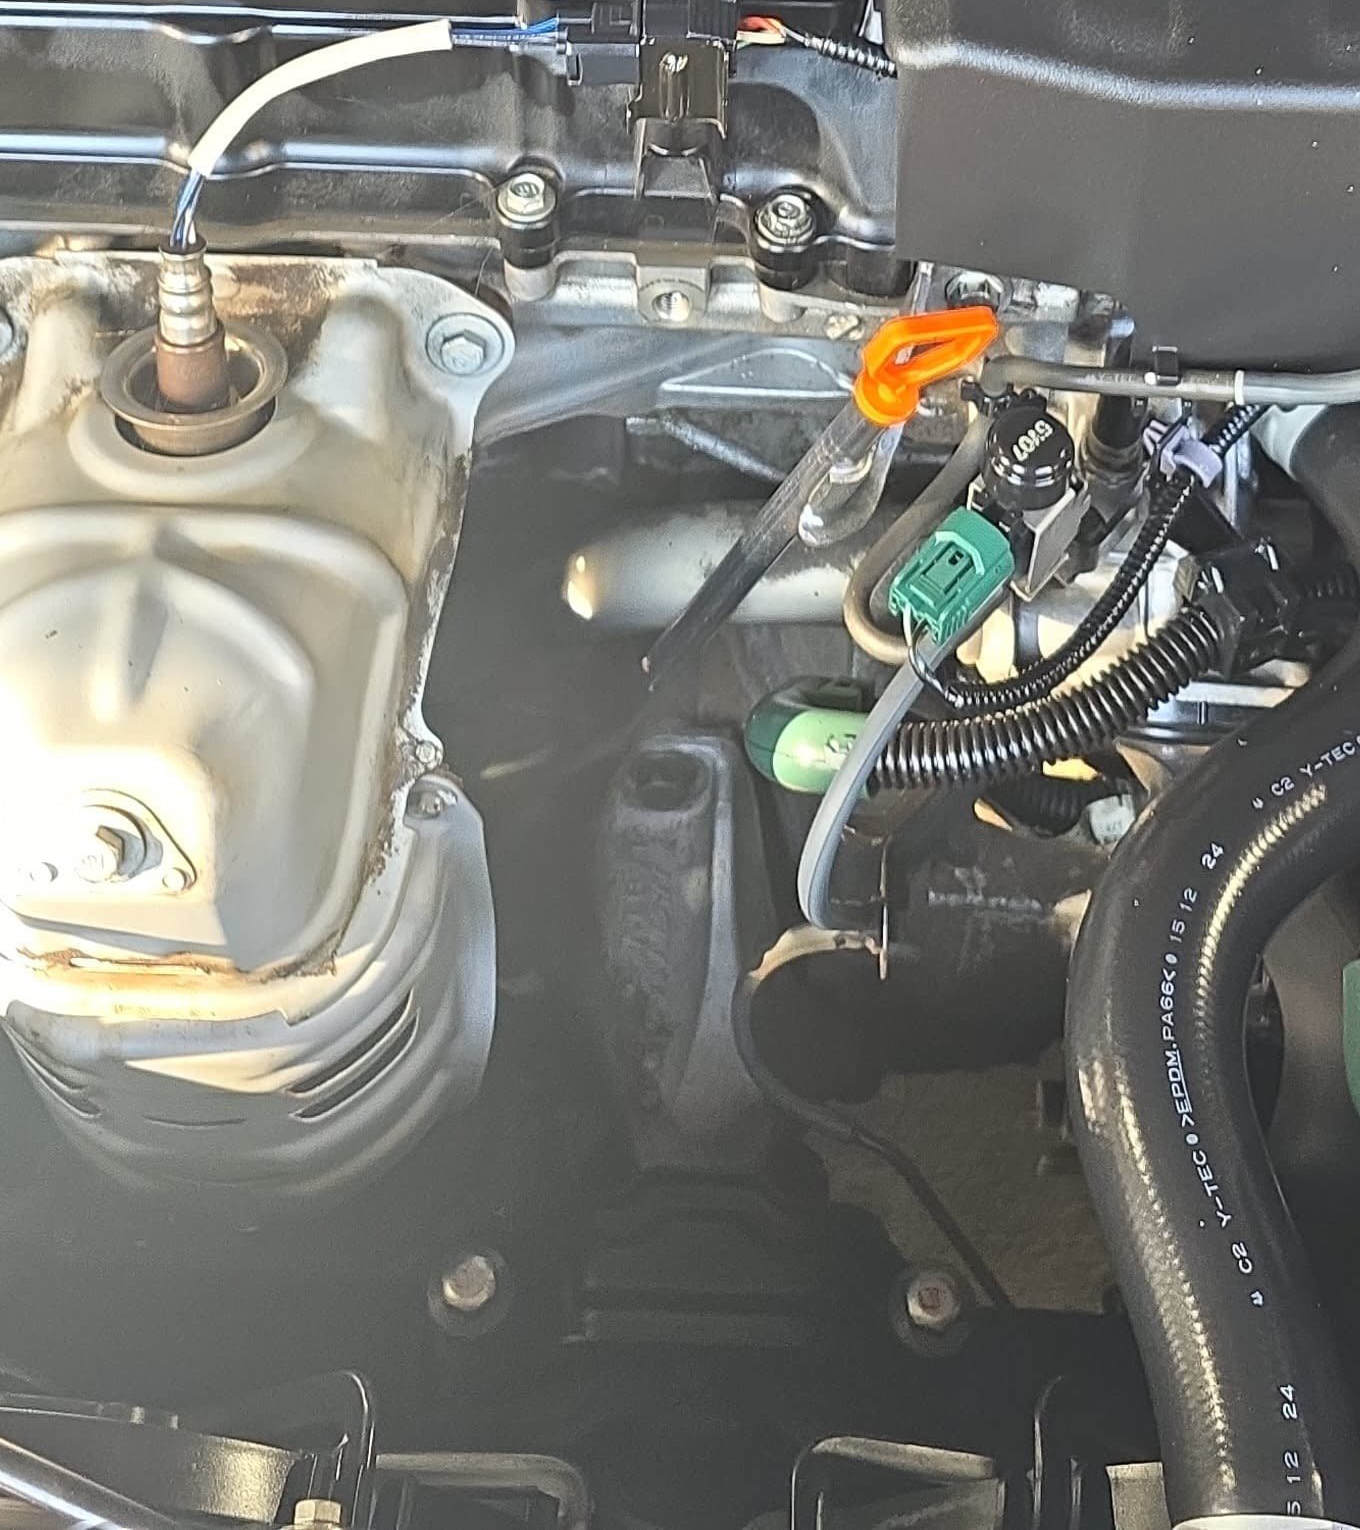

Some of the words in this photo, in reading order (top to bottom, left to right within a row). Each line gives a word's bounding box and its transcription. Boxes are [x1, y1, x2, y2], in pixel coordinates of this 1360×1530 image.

[1270, 776, 1295, 797] C2
[1299, 741, 1357, 778] Y-TEC
[1201, 842, 1225, 870] 24
[1179, 887, 1198, 913] 12
[1169, 919, 1186, 944] 15
[1192, 1149, 1233, 1229] Y-TEC
[1232, 1241, 1253, 1275] C2
[1279, 1383, 1298, 1420] 24
[1284, 1451, 1302, 1484] 12
